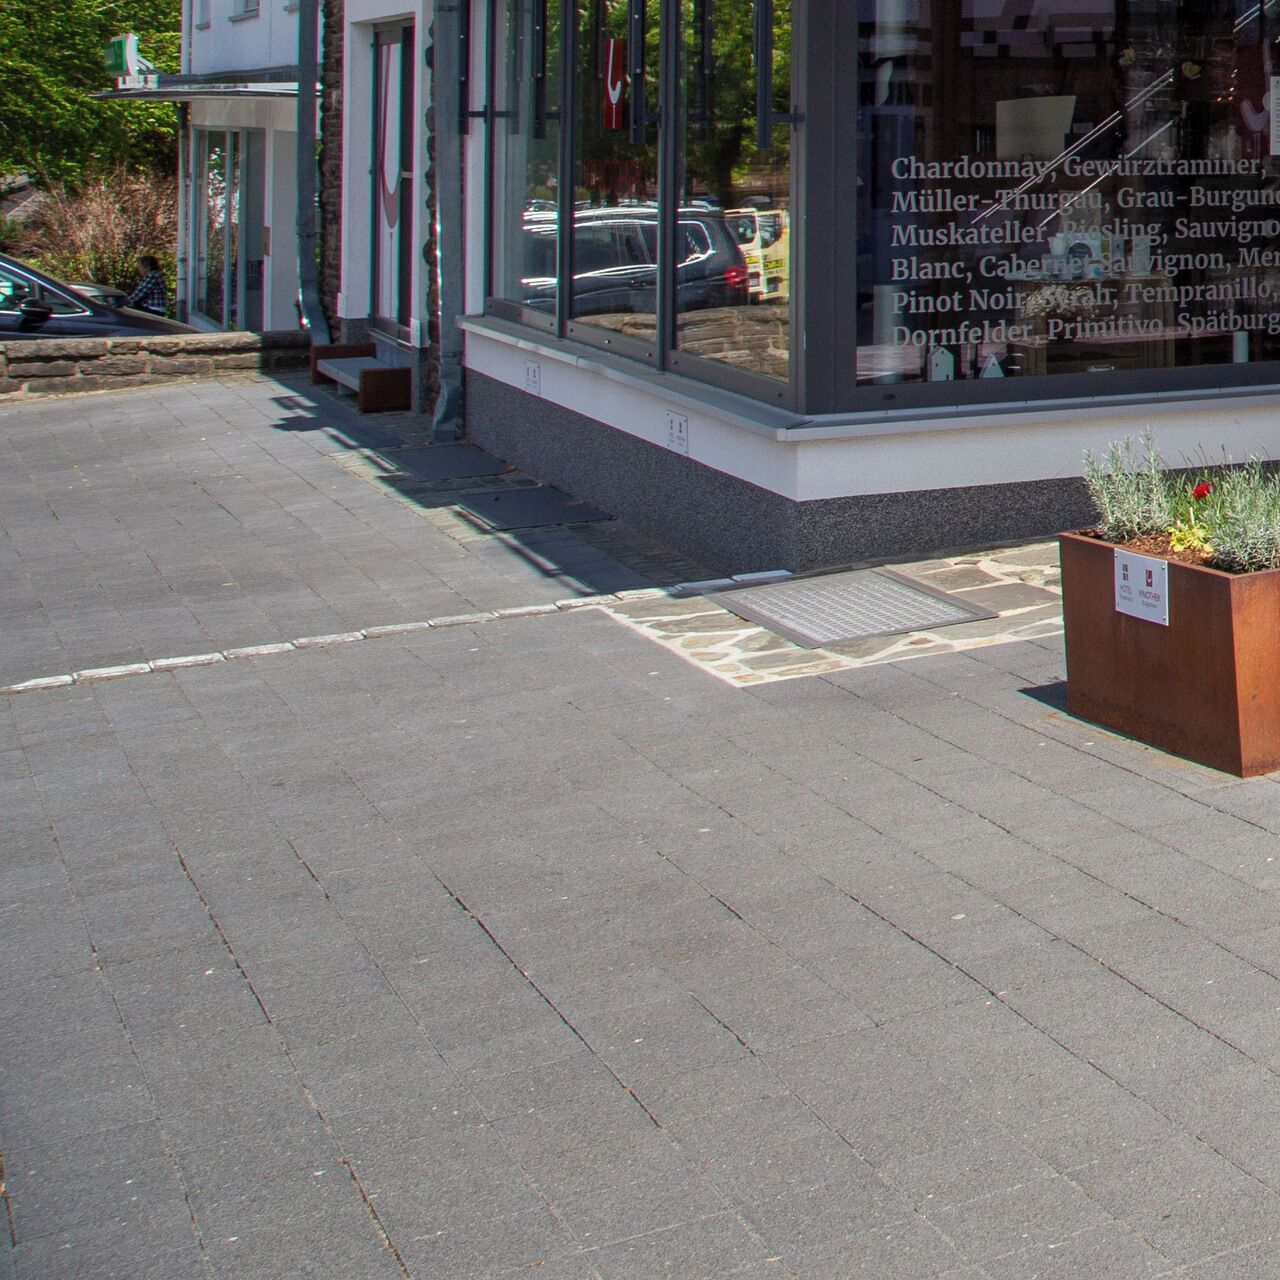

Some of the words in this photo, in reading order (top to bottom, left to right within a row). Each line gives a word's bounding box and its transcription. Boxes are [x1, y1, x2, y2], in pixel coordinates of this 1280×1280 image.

[891, 156, 1057, 183] Chardonnay,
[1063, 153, 1267, 179] Gewürztraminer,
[891, 188, 1111, 215] Müller-Thurgau,
[891, 221, 1054, 247] Muskateller,
[1061, 218, 1167, 245] Riesling,
[891, 256, 972, 284] Blanc,
[891, 290, 963, 314] Pinot
[1125, 277, 1279, 307] Tempranillo,
[892, 320, 1040, 347] Dornfelder,
